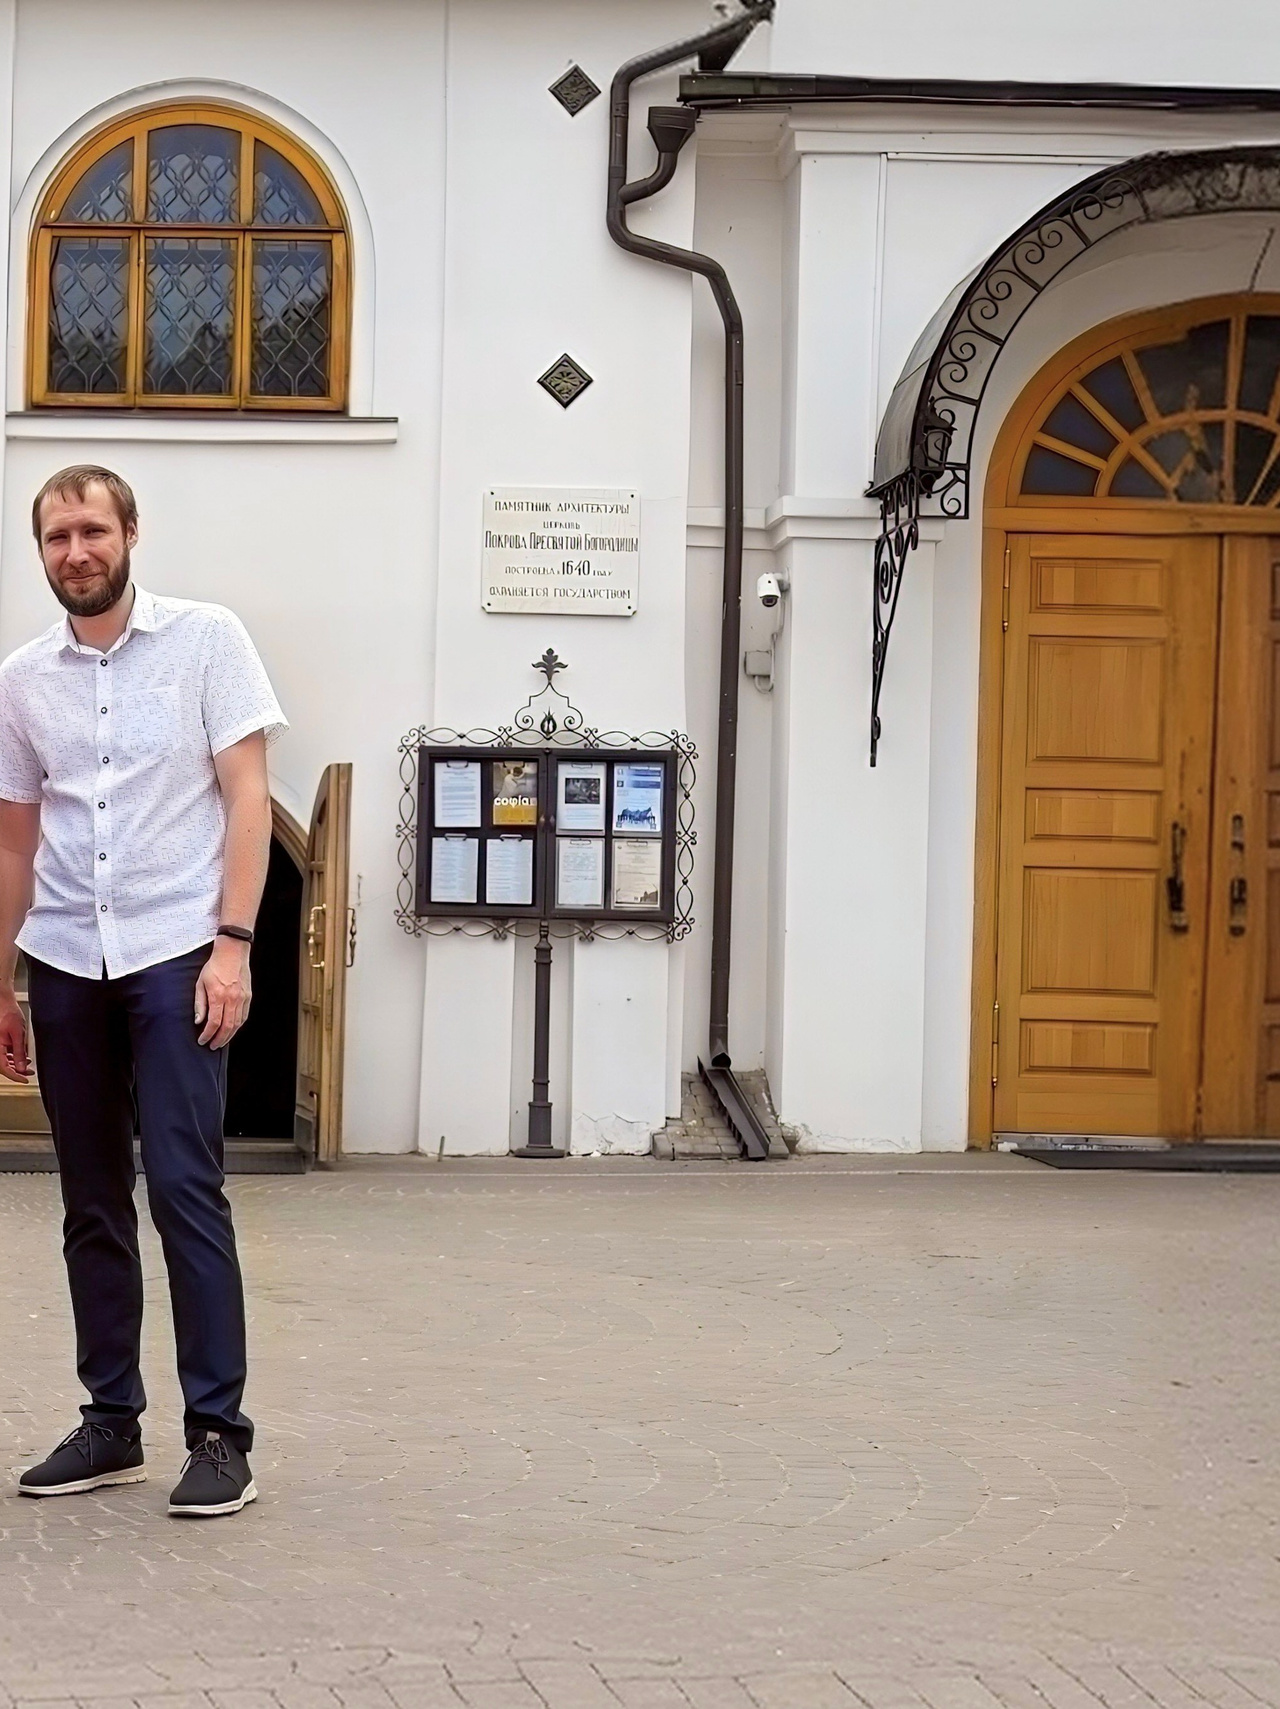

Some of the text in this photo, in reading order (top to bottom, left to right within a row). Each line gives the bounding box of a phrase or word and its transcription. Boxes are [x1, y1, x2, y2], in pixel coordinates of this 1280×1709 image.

[494, 501, 630, 514] ПАМЯТНИК АРХИТЕКТУРЫ
[562, 560, 591, 576] 1640
[554, 588, 631, 599] ГОСУДАРСТВОМ
